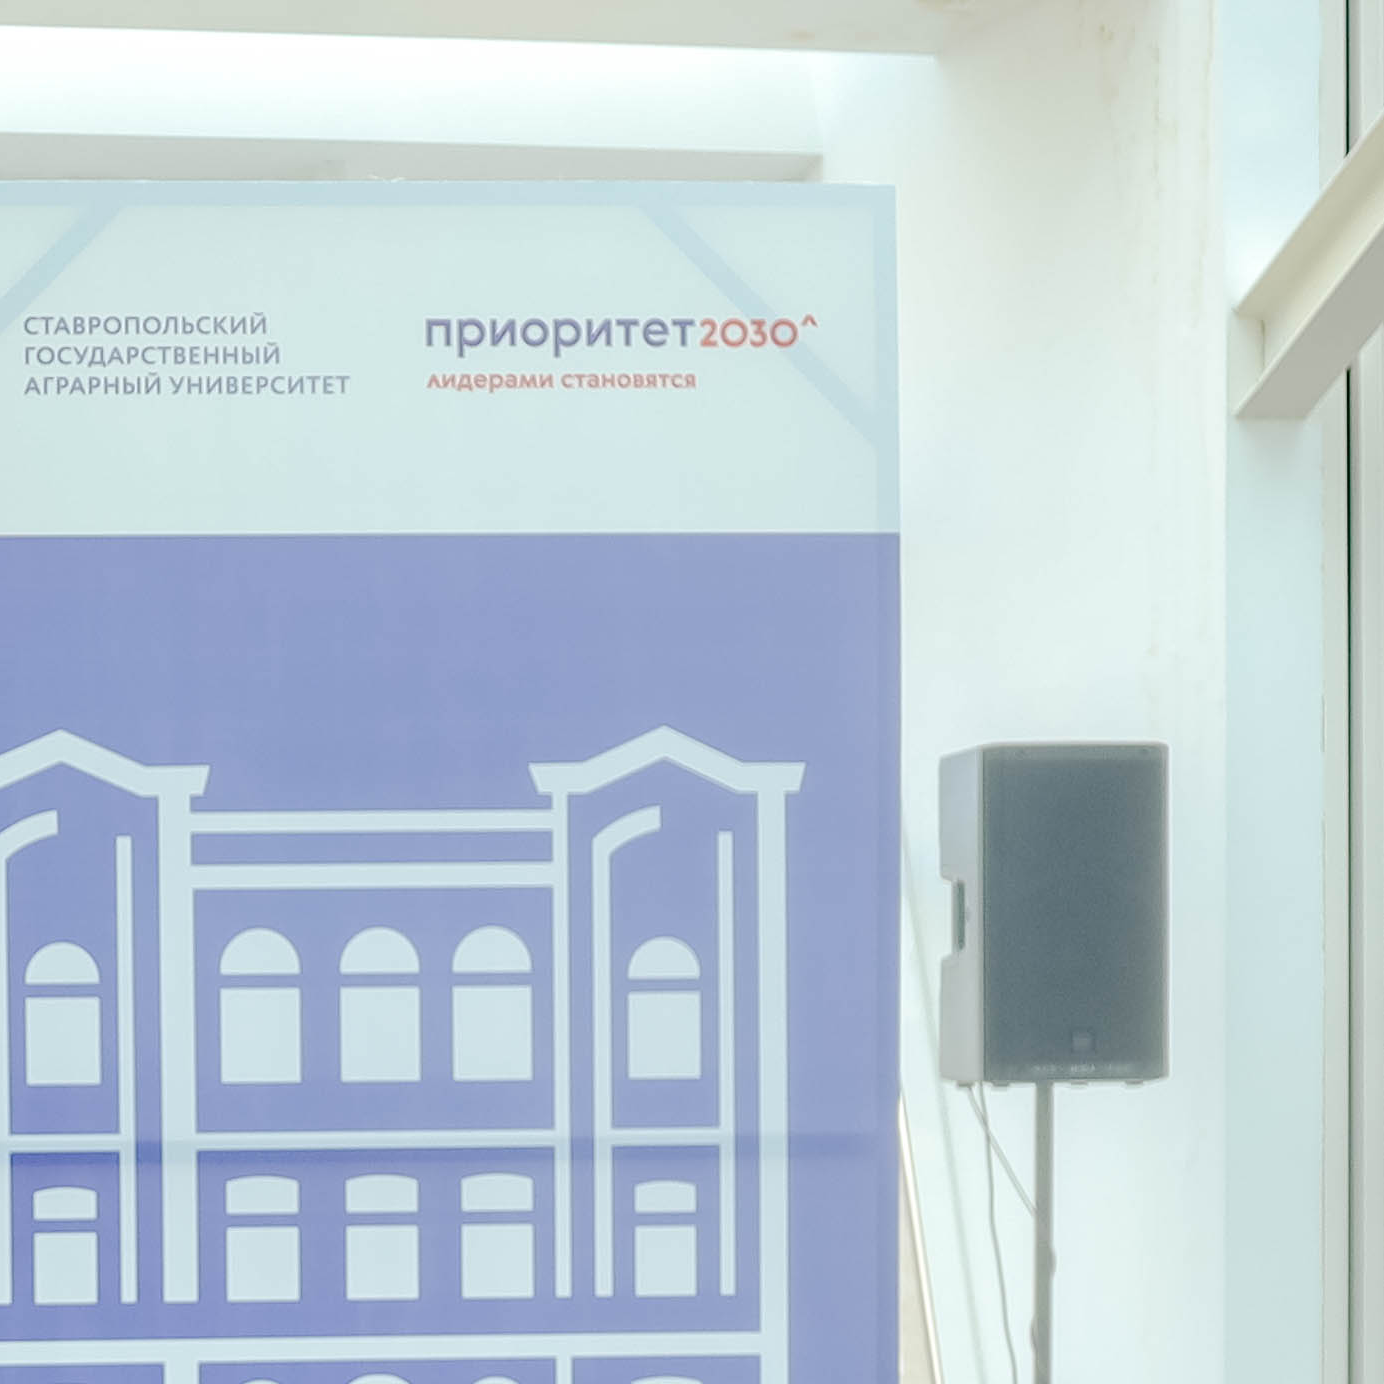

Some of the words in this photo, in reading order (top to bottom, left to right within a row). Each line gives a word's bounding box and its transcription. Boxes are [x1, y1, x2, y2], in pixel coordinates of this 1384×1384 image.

[23, 312, 267, 336] СТАВРОПОЛЬСКИЙ
[24, 341, 280, 368] ГОСУДАРСТВЕННЫЙ
[24, 372, 161, 396] АГРАРНЫЙ
[168, 375, 350, 396] УНИВЕРСИТЕТ
[426, 373, 554, 393] лидерами
[560, 373, 696, 389] становятся
